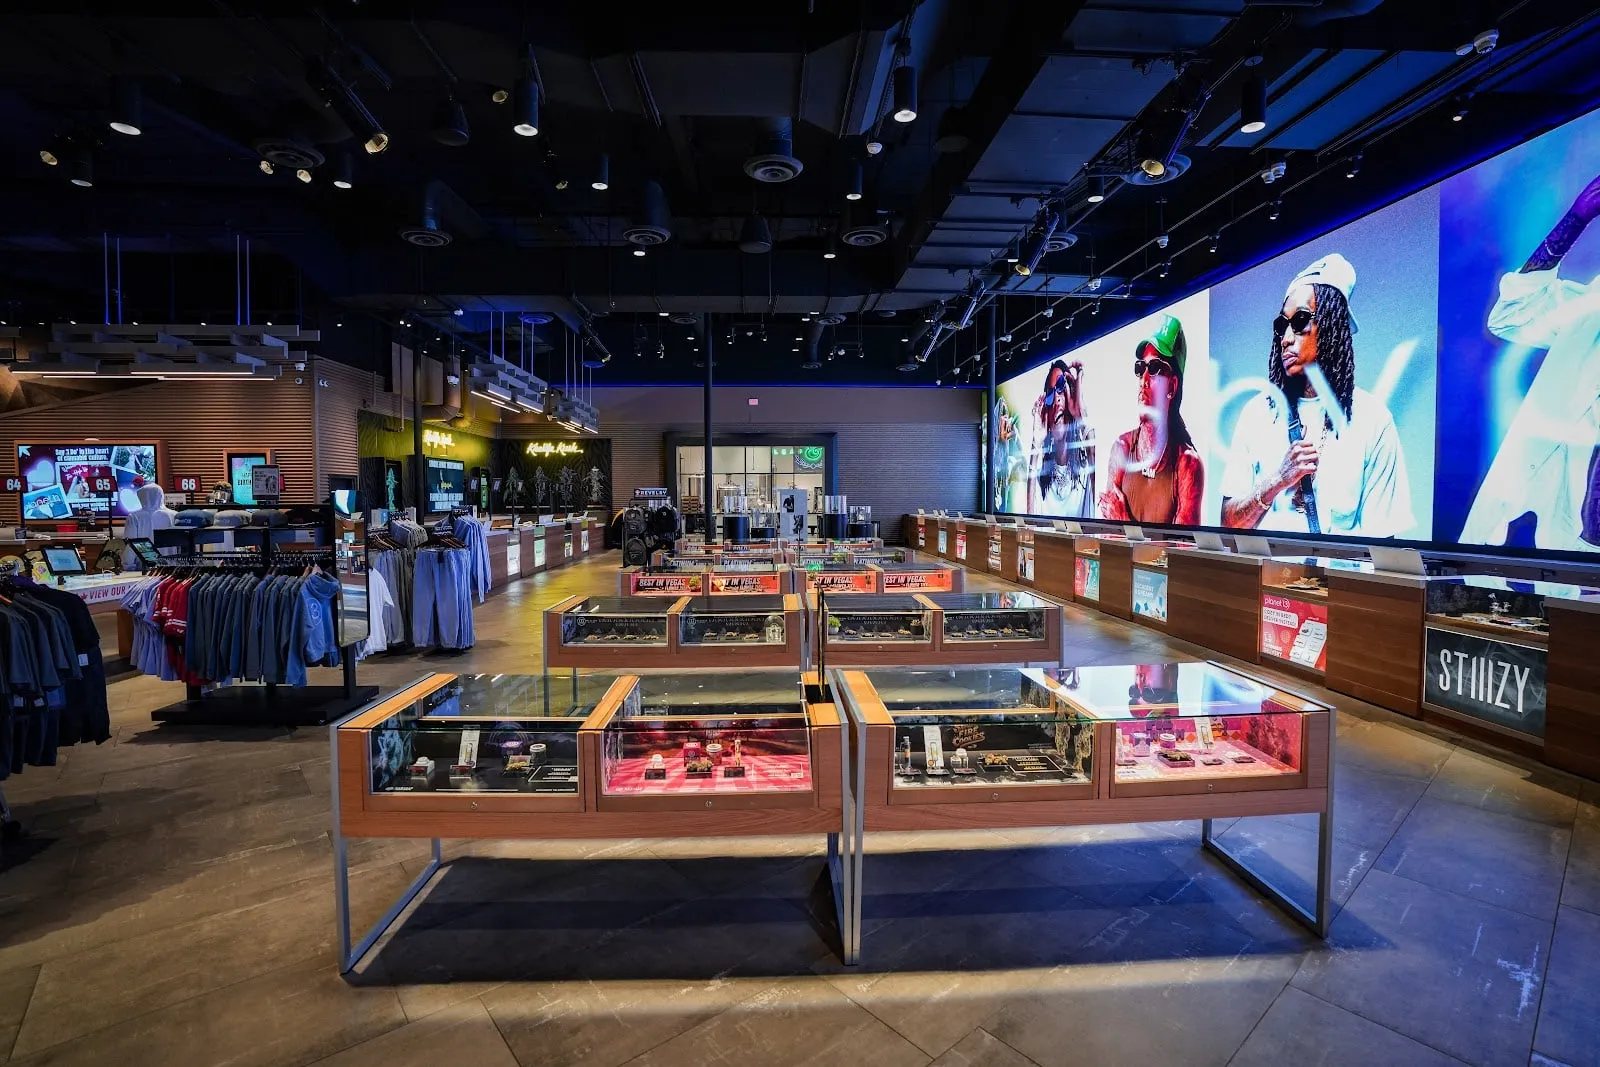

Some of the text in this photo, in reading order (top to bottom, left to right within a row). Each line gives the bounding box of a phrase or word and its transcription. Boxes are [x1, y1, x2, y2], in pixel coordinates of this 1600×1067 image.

[6, 478, 22, 491] 64
[95, 478, 111, 491] 65
[181, 478, 196, 491] 66
[639, 578, 686, 587] BEST IN VEGAS
[730, 578, 739, 586] IN
[740, 577, 761, 586] VEGAS
[824, 576, 832, 584] IN
[833, 576, 854, 584] VEGAS
[897, 575, 906, 583] IN
[906, 575, 926, 583] VEGAS
[90, 588, 108, 600] VIEW
[111, 585, 126, 597] OUR
[1264, 597, 1282, 607] planet
[1439, 648, 1530, 713] STIIIZY
[958, 727, 978, 737] FIRE
[952, 731, 985, 748] COOKIES
